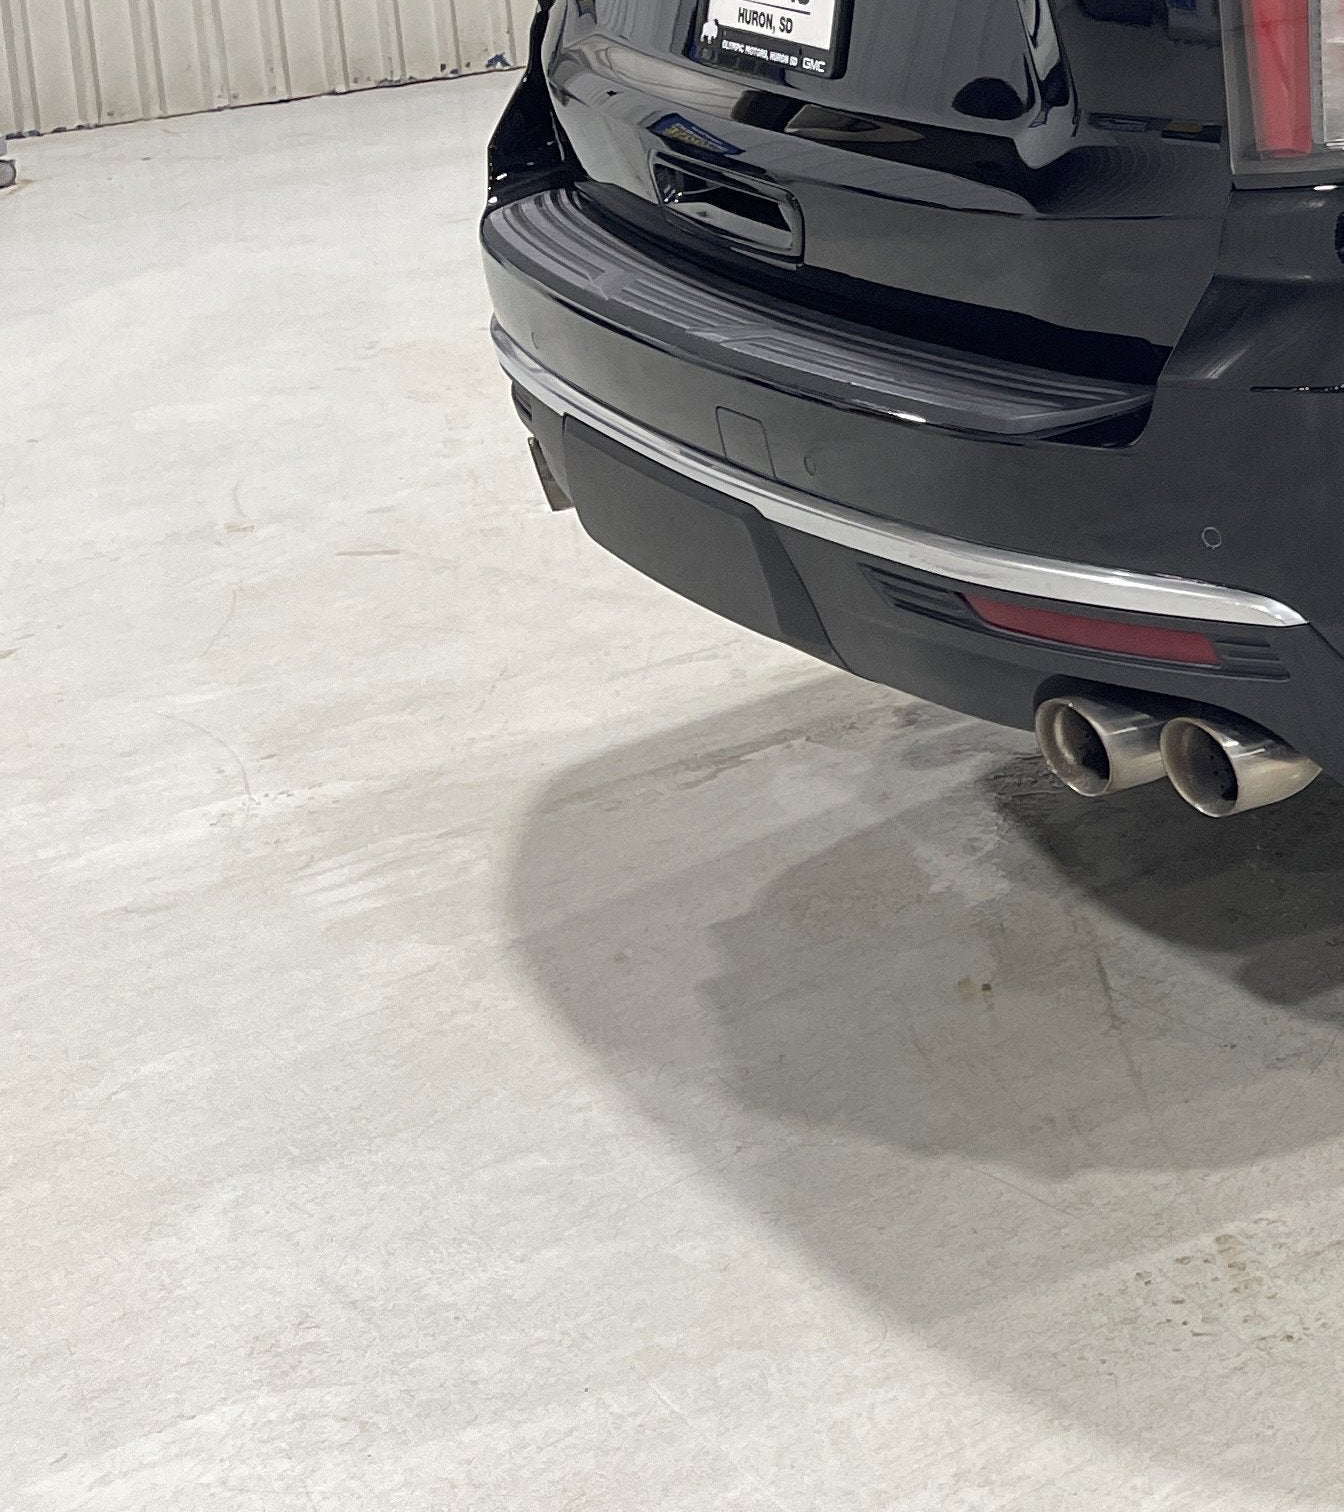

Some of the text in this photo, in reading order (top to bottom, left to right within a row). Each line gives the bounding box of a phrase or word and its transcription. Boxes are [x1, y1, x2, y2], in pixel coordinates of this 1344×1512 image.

[738, 7, 793, 34] HURON, SD
[802, 57, 826, 73] GMC
